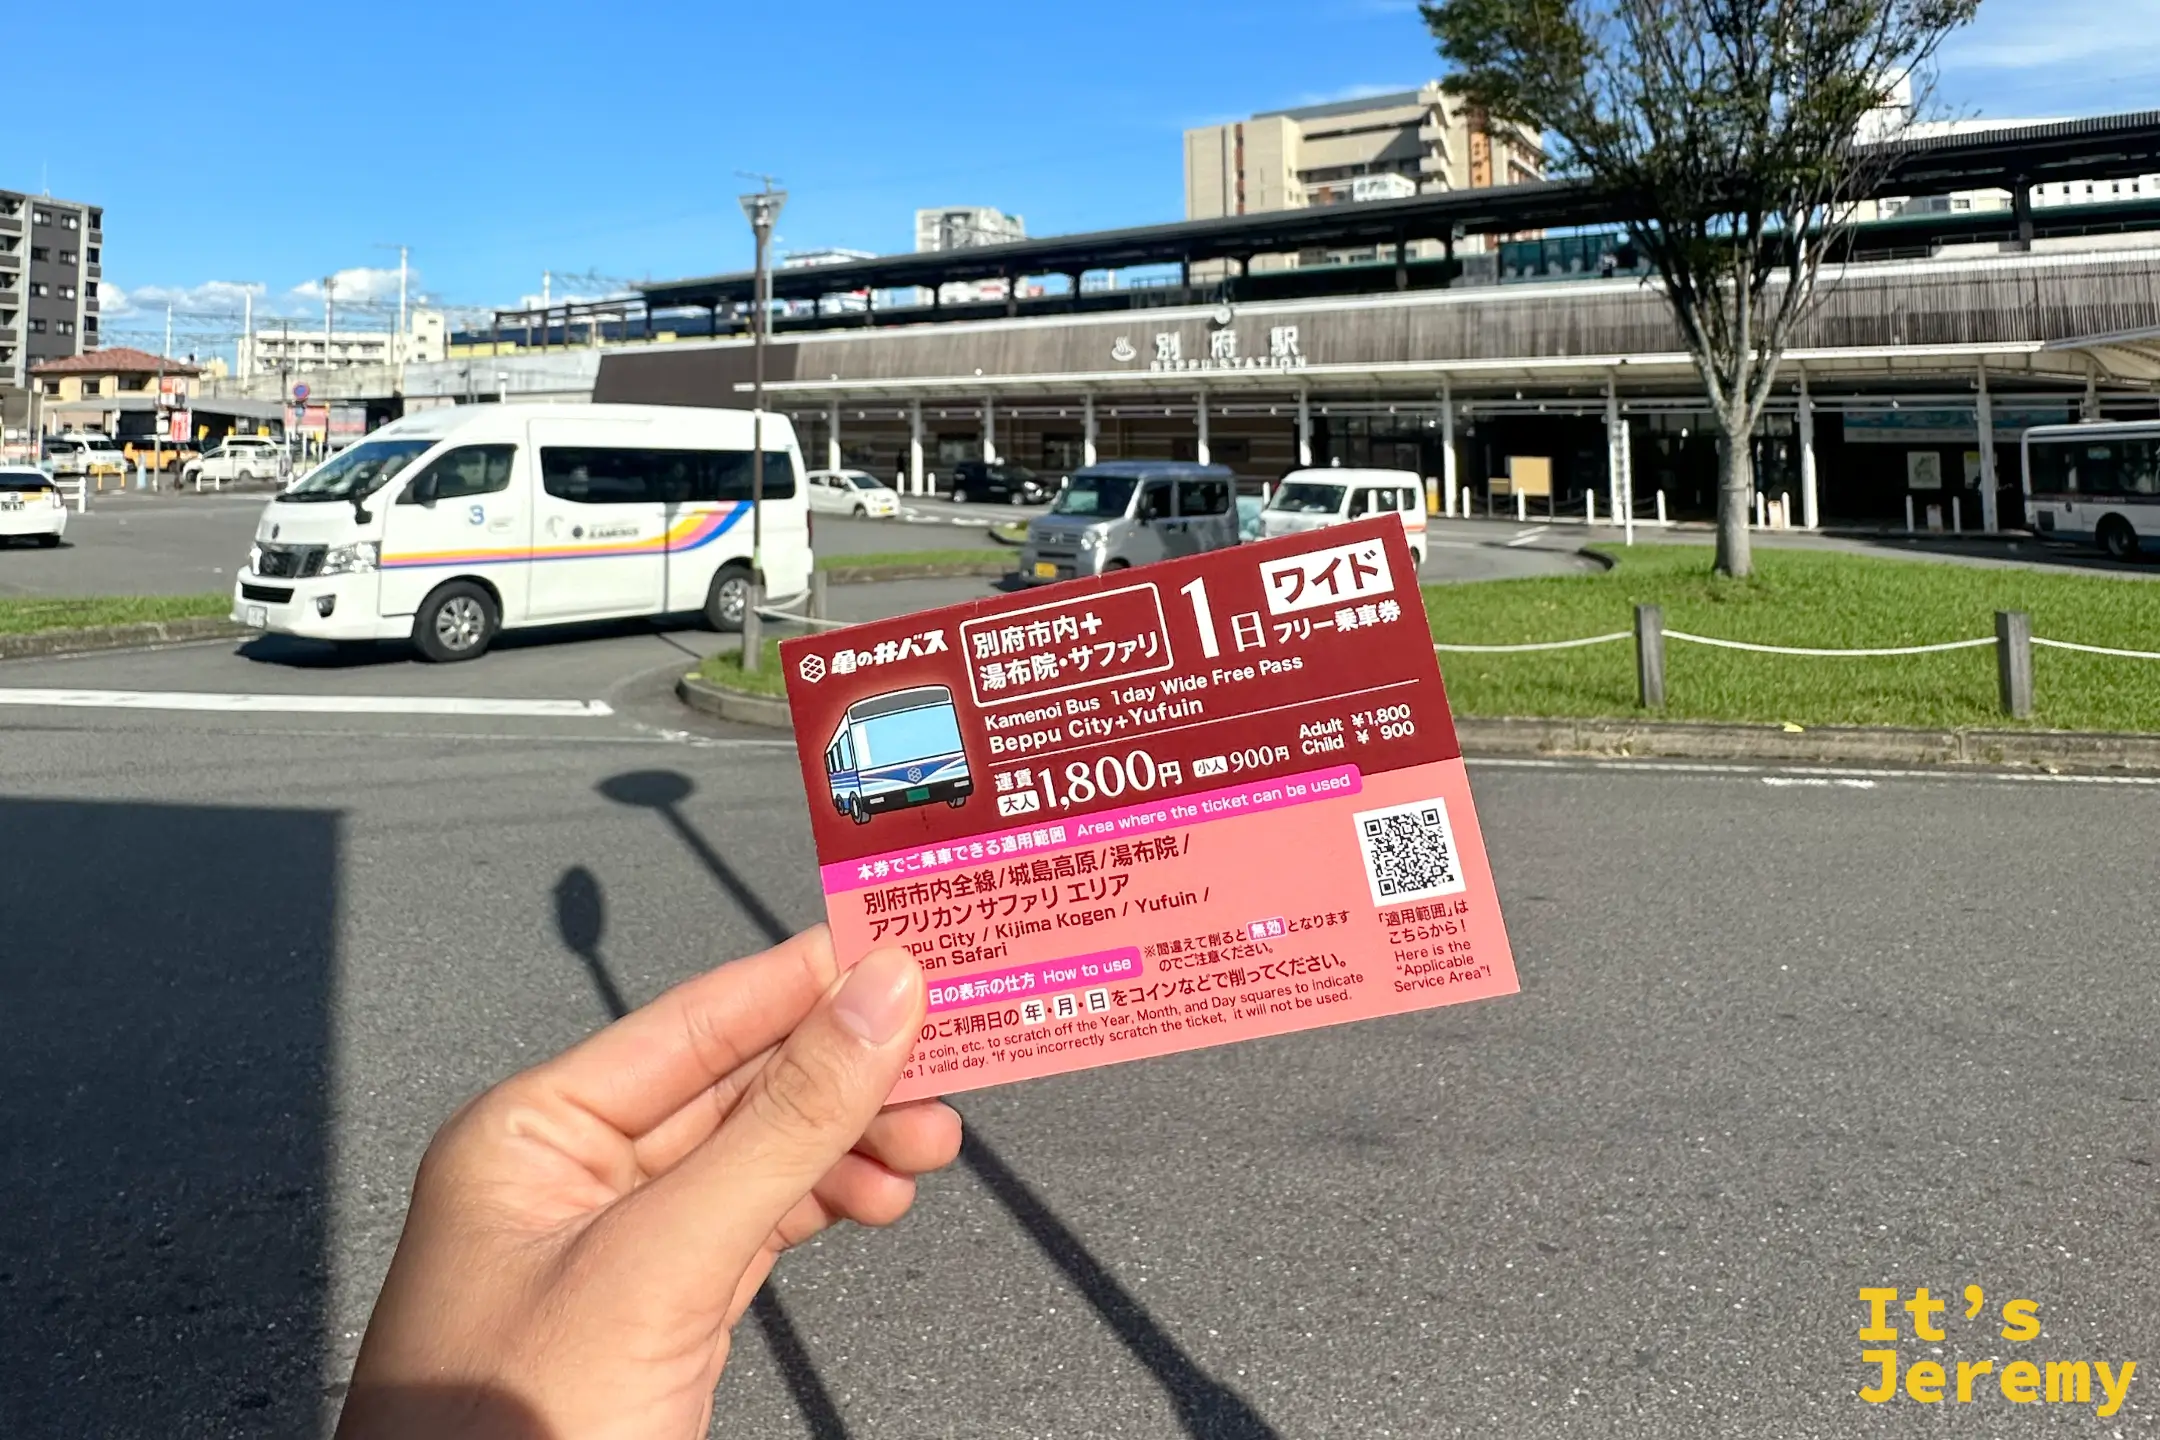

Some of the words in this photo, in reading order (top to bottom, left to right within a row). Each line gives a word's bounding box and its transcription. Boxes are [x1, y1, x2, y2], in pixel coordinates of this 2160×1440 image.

[1156, 326, 1300, 361] 別府駅
[1219, 354, 1306, 370] STATION
[469, 505, 485, 525] 3
[1271, 549, 1378, 604] ワイド
[1272, 599, 1400, 643] フリー乗車券
[830, 629, 948, 674] 亀の井バス
[984, 701, 1062, 730] Kamenoi
[1065, 697, 1100, 714] Bus
[1159, 674, 1207, 695] Wide
[1211, 666, 1254, 685] Free
[1258, 656, 1303, 675] Pass
[989, 727, 1061, 753] Beppu
[1068, 698, 1203, 738] City+Yufuin
[1299, 718, 1344, 738] Adult
[1301, 733, 1344, 755] Child
[1380, 720, 1414, 739] 900
[994, 767, 1033, 792] 運賃
[1077, 820, 1114, 836] Area
[1117, 810, 1166, 828] where
[1170, 805, 1197, 818] the
[1201, 793, 1248, 813] ticket
[1252, 789, 1282, 803] can
[1285, 784, 1306, 797] be
[1310, 773, 1350, 792] used
[857, 825, 1066, 880] 本券でご乗車できる適用範囲
[938, 932, 975, 949] City
[994, 919, 1051, 939] Kijima
[1056, 907, 1116, 928] Kogen
[1134, 891, 1197, 913] Yufuin
[951, 941, 1007, 964] Safari
[1158, 942, 1273, 971] のでご注意ください。
[1393, 948, 1428, 962] Here
[1432, 945, 1444, 955] is
[1447, 940, 1471, 952] the
[1042, 968, 1076, 983] How
[1080, 964, 1098, 976] to
[1102, 958, 1131, 973] use
[1393, 975, 1444, 992] Service
[928, 972, 1034, 1005] 日の表示の仕方
[917, 1064, 923, 1076] 1
[929, 1057, 958, 1074] valid
[962, 1055, 987, 1068] day.
[1009, 1047, 1033, 1062] you
[1036, 1033, 1104, 1054] incorrectly
[1109, 1023, 1157, 1041] scratch
[1160, 1020, 1182, 1032] the
[1185, 1011, 1226, 1027] ticket,
[1233, 1008, 1243, 1019] it
[1245, 1003, 1266, 1016] will
[1270, 999, 1292, 1013] not
[1294, 996, 1312, 1008] be
[1315, 988, 1351, 1004] used.
[918, 1051, 925, 1060] a
[929, 1044, 958, 1058] coin,
[961, 1041, 984, 1053] etc.
[987, 1037, 1000, 1048] to
[1004, 1026, 1051, 1045] scratch
[1054, 1021, 1072, 1036] off
[1076, 1019, 1097, 1032] the
[1099, 1014, 1134, 1027] Year,
[1136, 1004, 1181, 1021] Month,
[1184, 998, 1208, 1012] and
[1211, 996, 1235, 1008] Day
[1240, 986, 1292, 1003] squares
[1294, 982, 1308, 993] to
[1311, 973, 1363, 990] indicate
